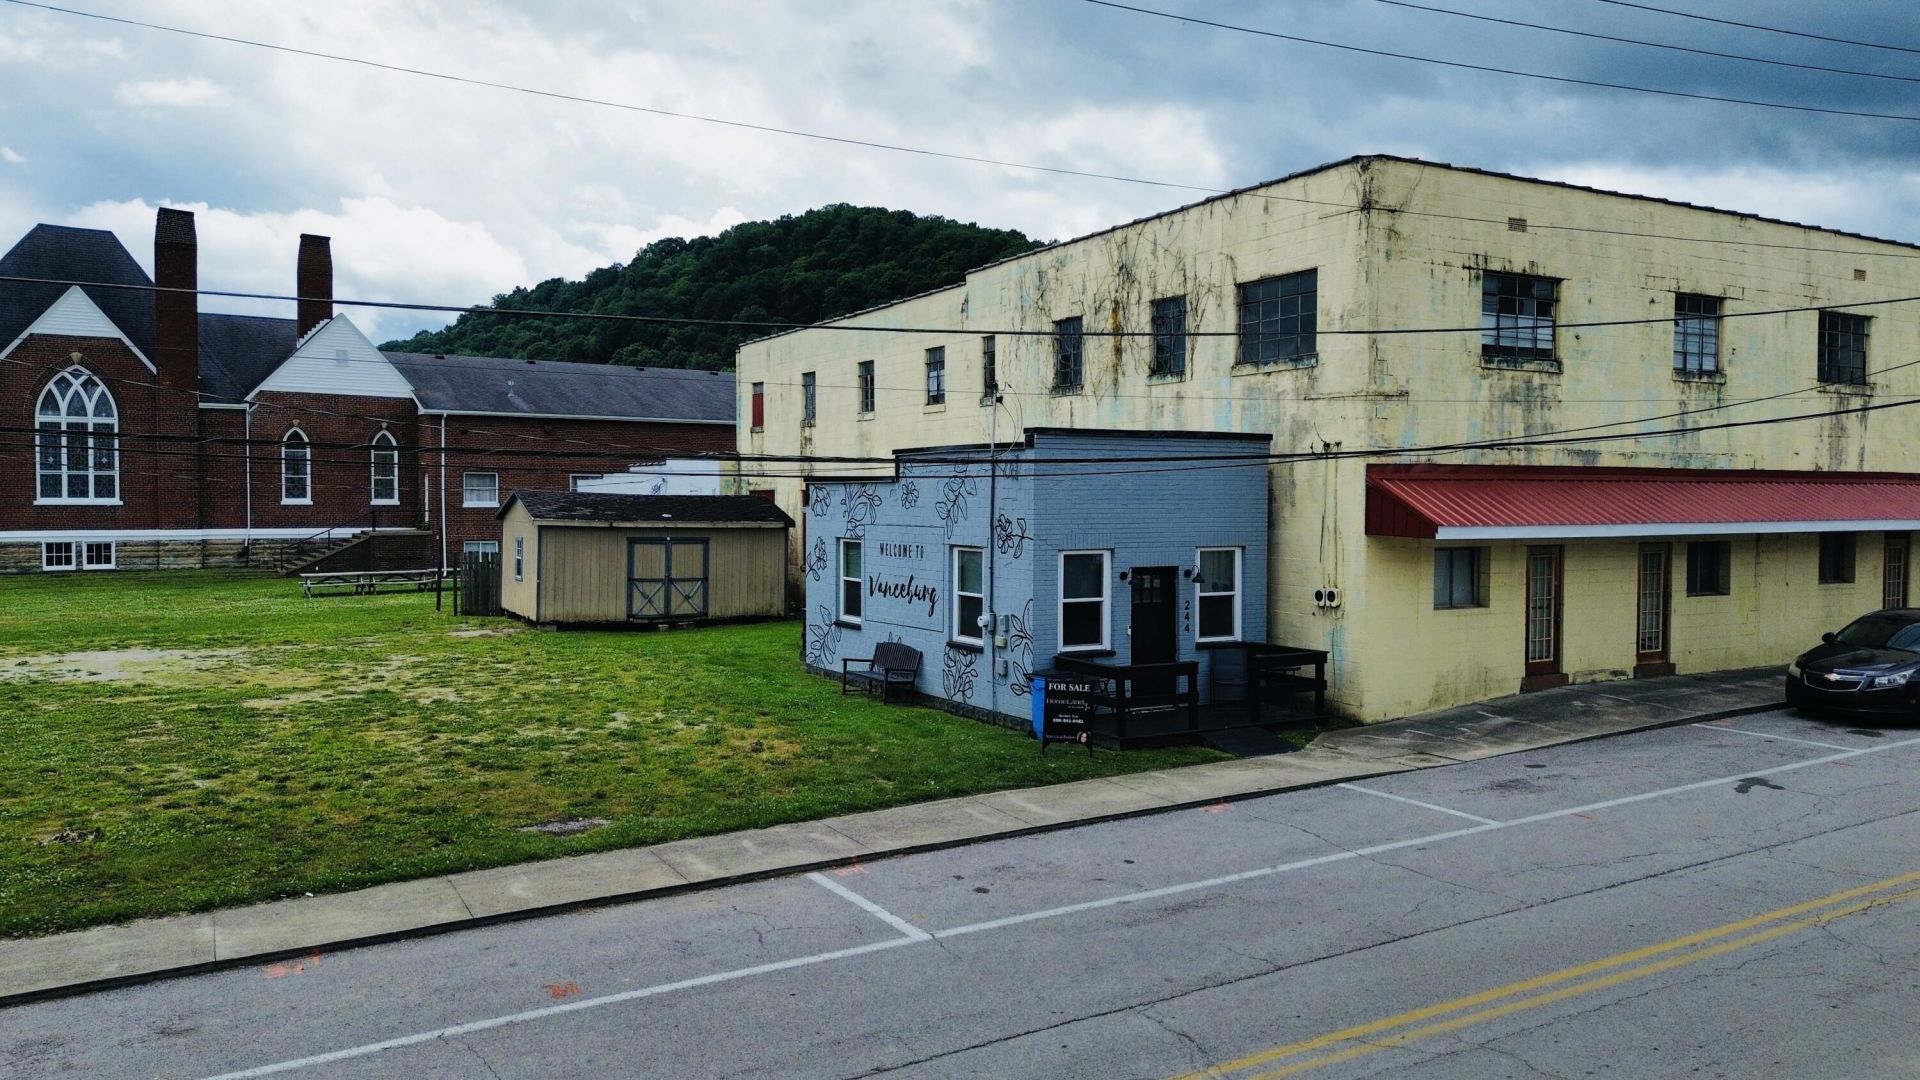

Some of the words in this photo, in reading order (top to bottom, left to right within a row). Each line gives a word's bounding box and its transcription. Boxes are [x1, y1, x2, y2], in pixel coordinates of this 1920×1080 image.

[879, 543, 912, 558] WELCOME
[916, 545, 924, 559] TO
[869, 572, 939, 617] Vanceburg
[1048, 682, 1067, 691] FOR
[1069, 683, 1091, 692] SALE
